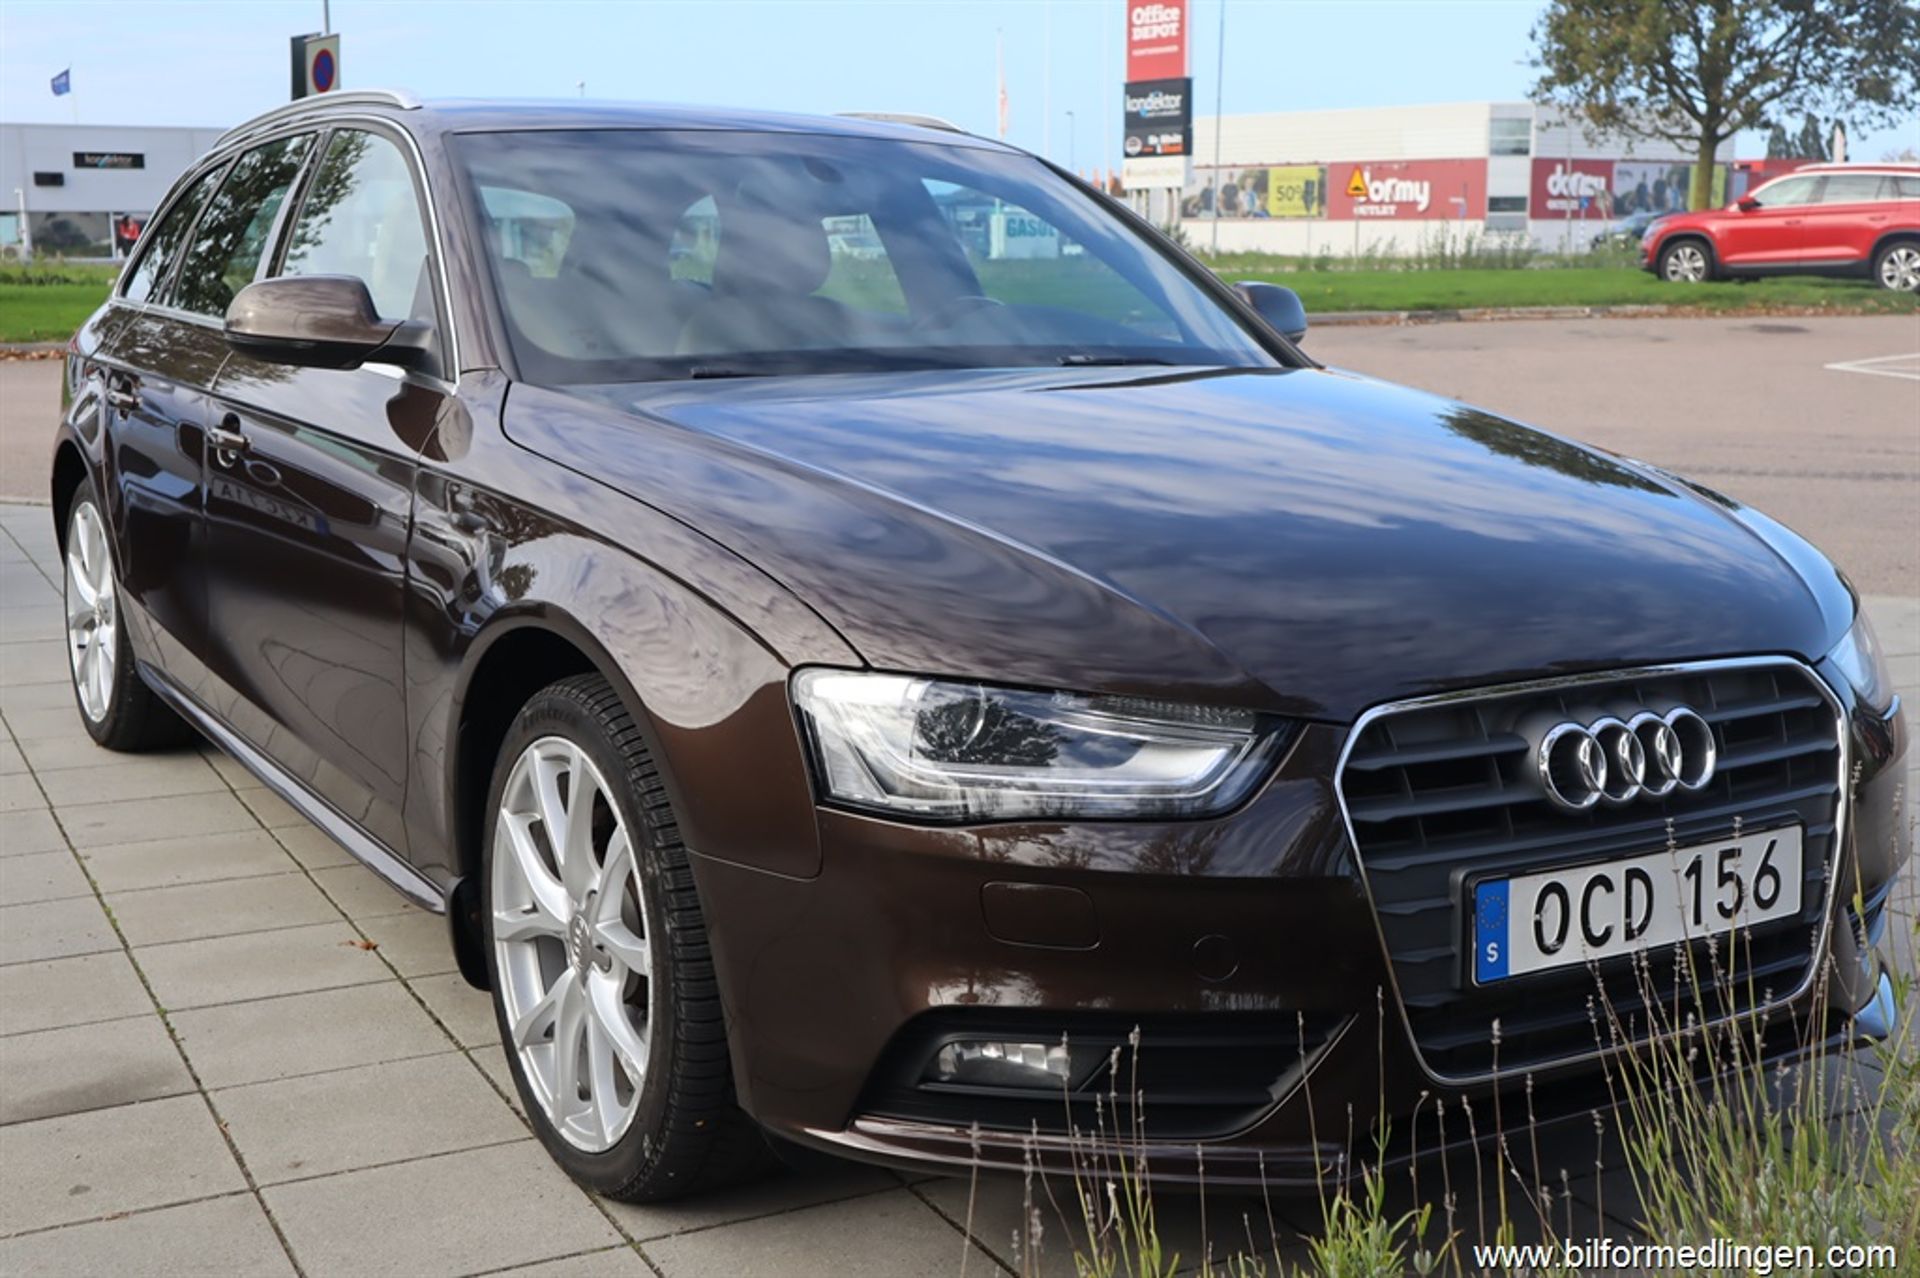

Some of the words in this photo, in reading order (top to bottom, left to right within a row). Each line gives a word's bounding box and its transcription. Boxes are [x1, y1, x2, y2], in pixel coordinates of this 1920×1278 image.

[1131, 3, 1181, 25] Office
[1131, 22, 1181, 41] DEPOT
[1533, 866, 1655, 955] OCD
[1684, 838, 1781, 927] 156
[1486, 941, 1500, 963] S
